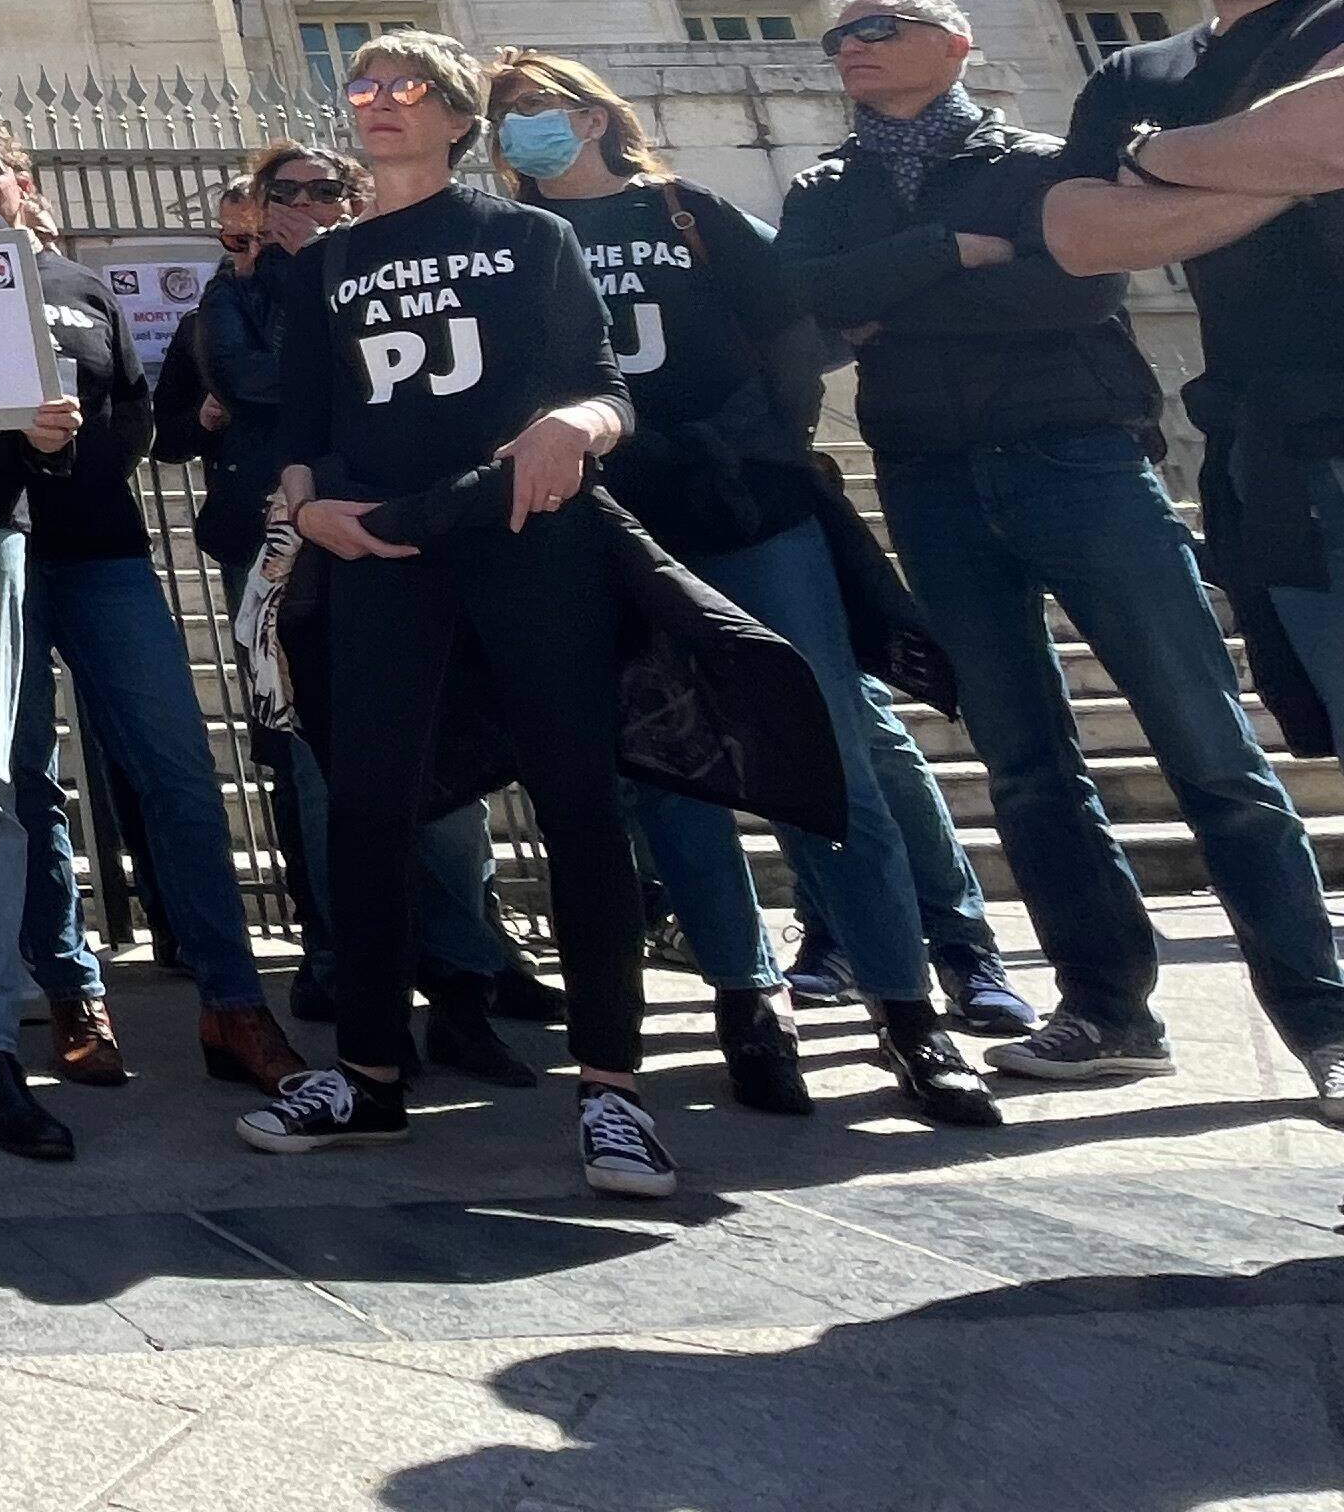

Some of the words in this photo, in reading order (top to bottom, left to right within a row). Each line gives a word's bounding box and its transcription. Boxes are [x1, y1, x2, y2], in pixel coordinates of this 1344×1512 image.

[447, 248, 516, 280] PAS
[631, 240, 692, 269] PAS
[365, 299, 392, 326] A
[399, 287, 462, 319] MA
[359, 317, 484, 405] PJ
